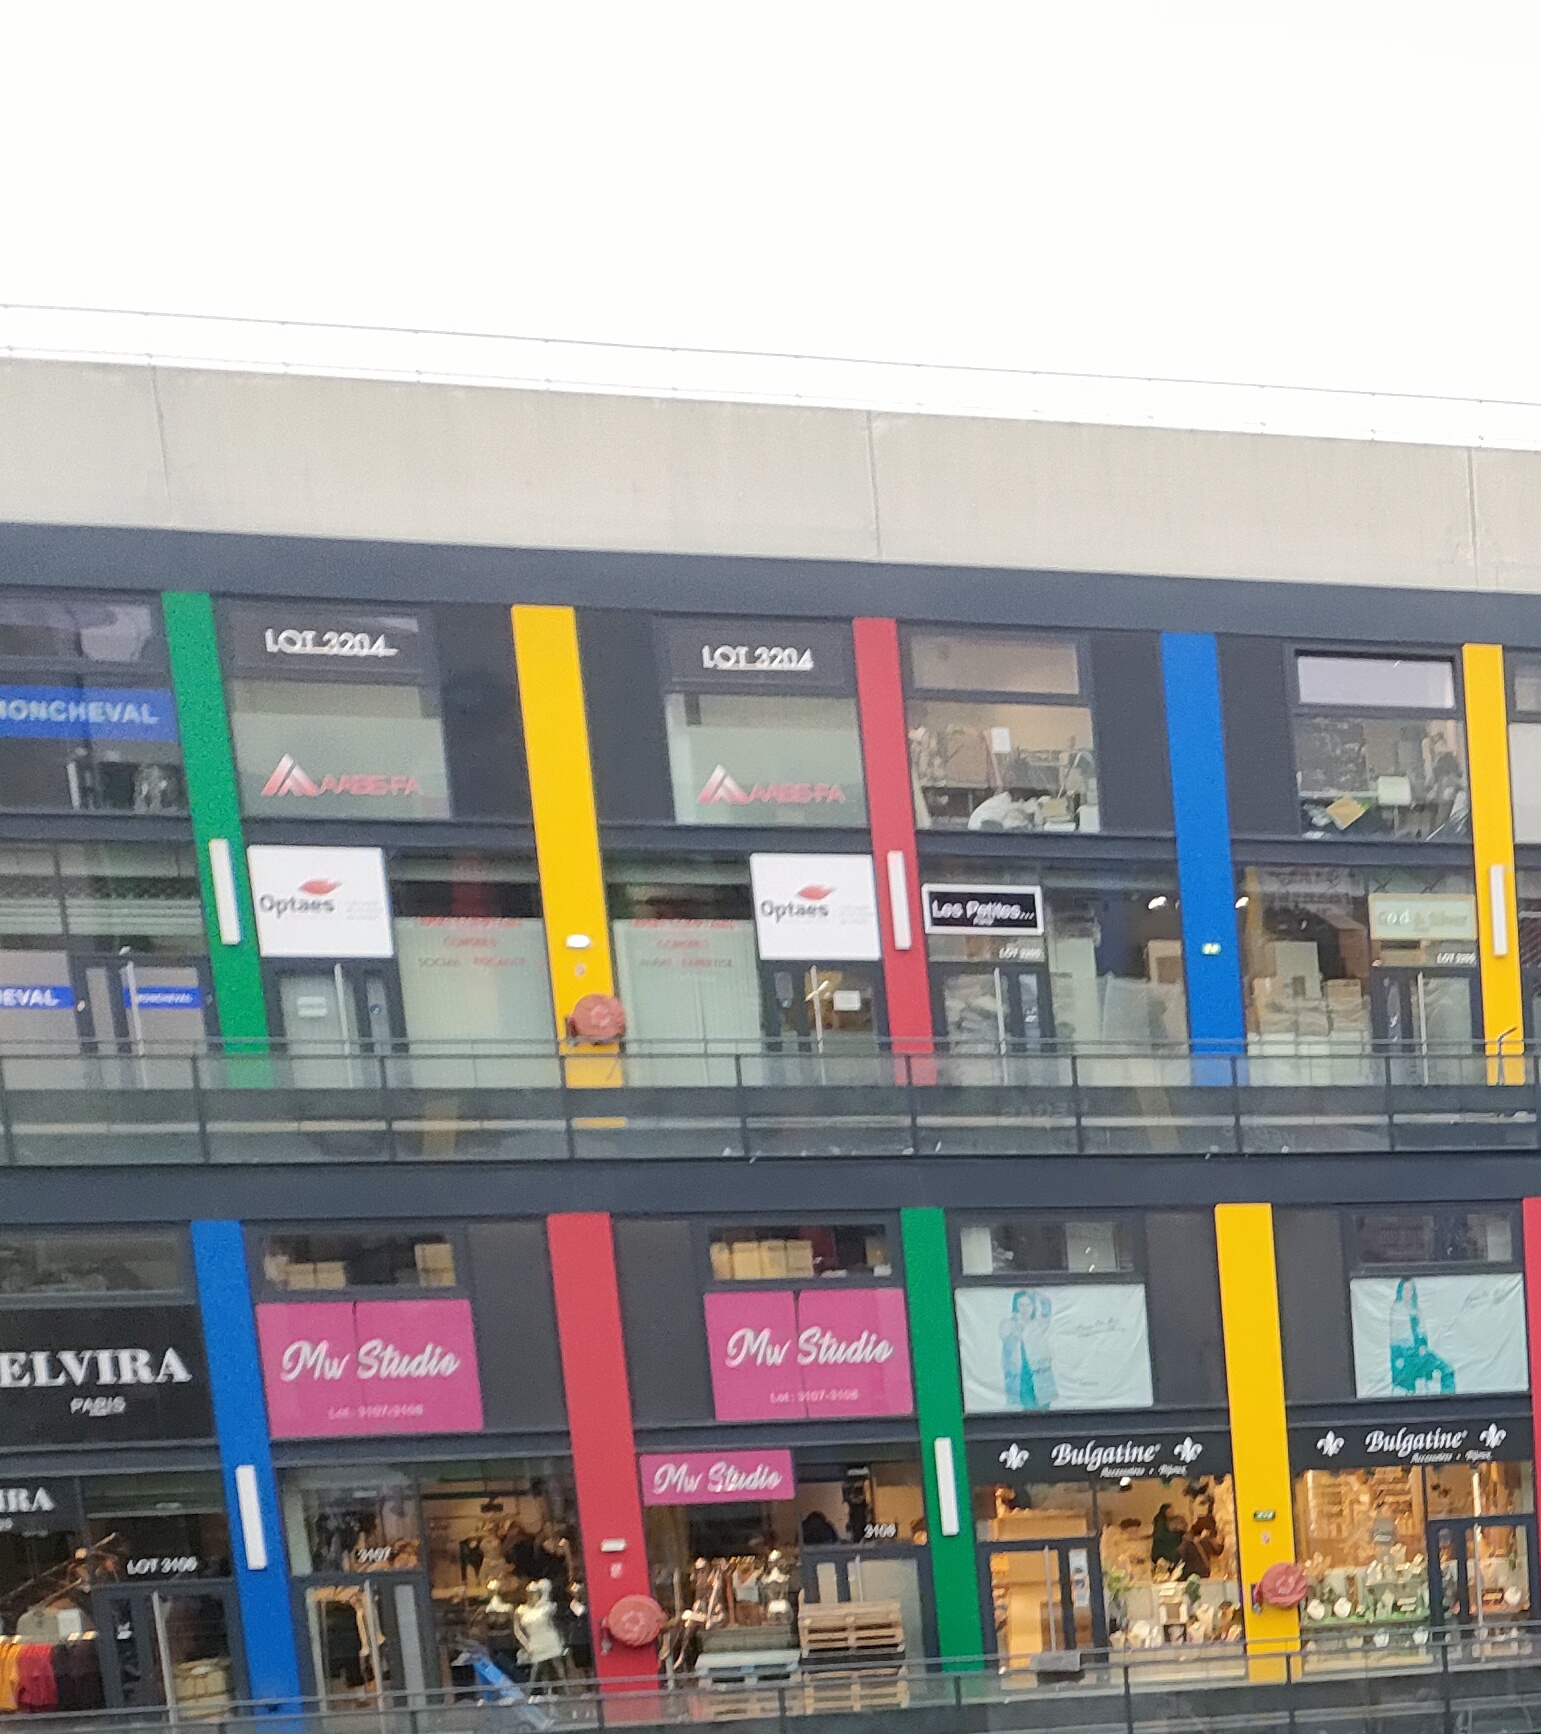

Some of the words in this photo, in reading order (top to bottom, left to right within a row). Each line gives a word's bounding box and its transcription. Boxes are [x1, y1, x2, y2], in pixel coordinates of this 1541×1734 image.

[265, 628, 316, 654] LOT
[702, 645, 748, 669] LOT
[755, 646, 814, 671] 3204
[760, 900, 829, 922] Optaes
[356, 1338, 461, 1381] Studio
[797, 1325, 894, 1365] Studio
[0, 1346, 193, 1388] ELVIRA
[70, 1397, 127, 1417] PARIS
[1051, 1440, 1161, 1472] Bulgatine
[1365, 1427, 1468, 1458] Bulgatine
[707, 1461, 782, 1493] Studio
[127, 1558, 158, 1575] LOT
